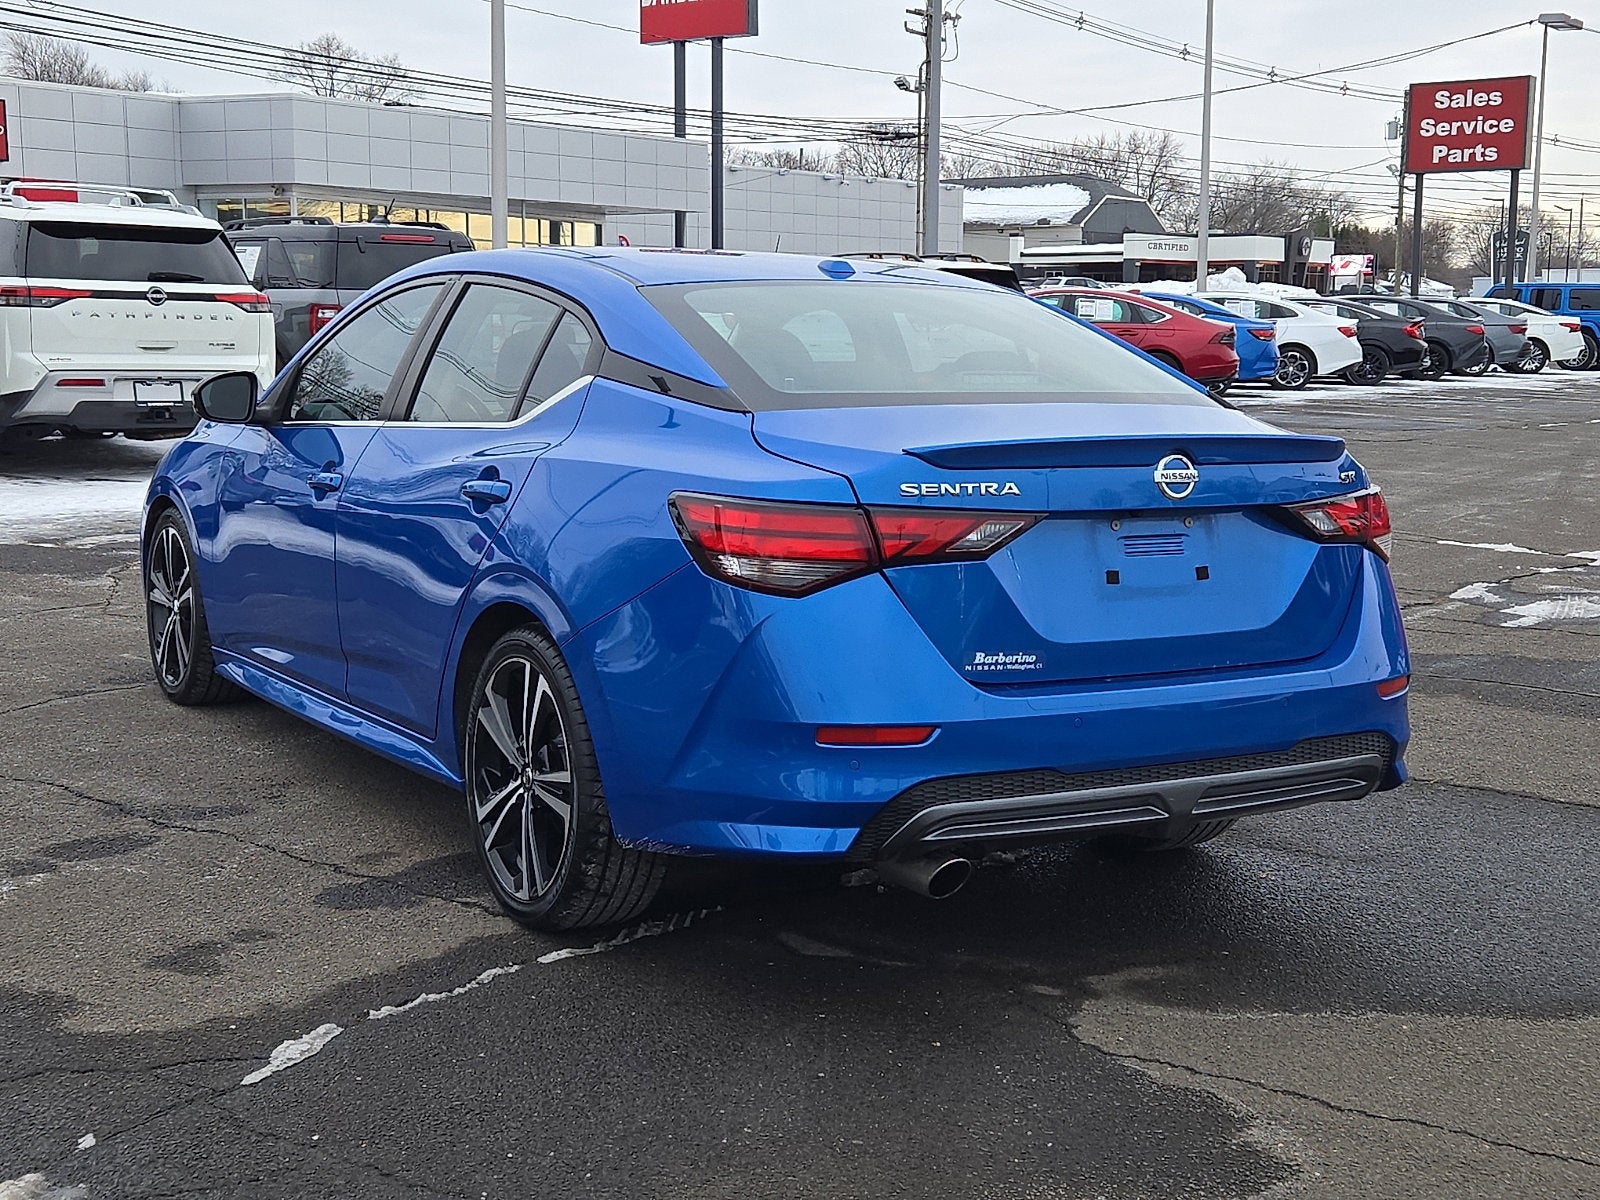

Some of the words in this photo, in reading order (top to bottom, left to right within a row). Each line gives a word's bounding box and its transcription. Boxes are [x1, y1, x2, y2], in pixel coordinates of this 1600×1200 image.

[1434, 89, 1503, 109] Sales
[1420, 116, 1515, 137] Service
[1432, 144, 1498, 163] Parts
[1147, 242, 1189, 252] CERTIFIED
[71, 310, 234, 321] PATHFINDER
[1160, 472, 1196, 480] NISSAN
[1340, 470, 1356, 484] SR
[900, 482, 1021, 496] SENTRA
[973, 651, 1036, 664] Barberino
